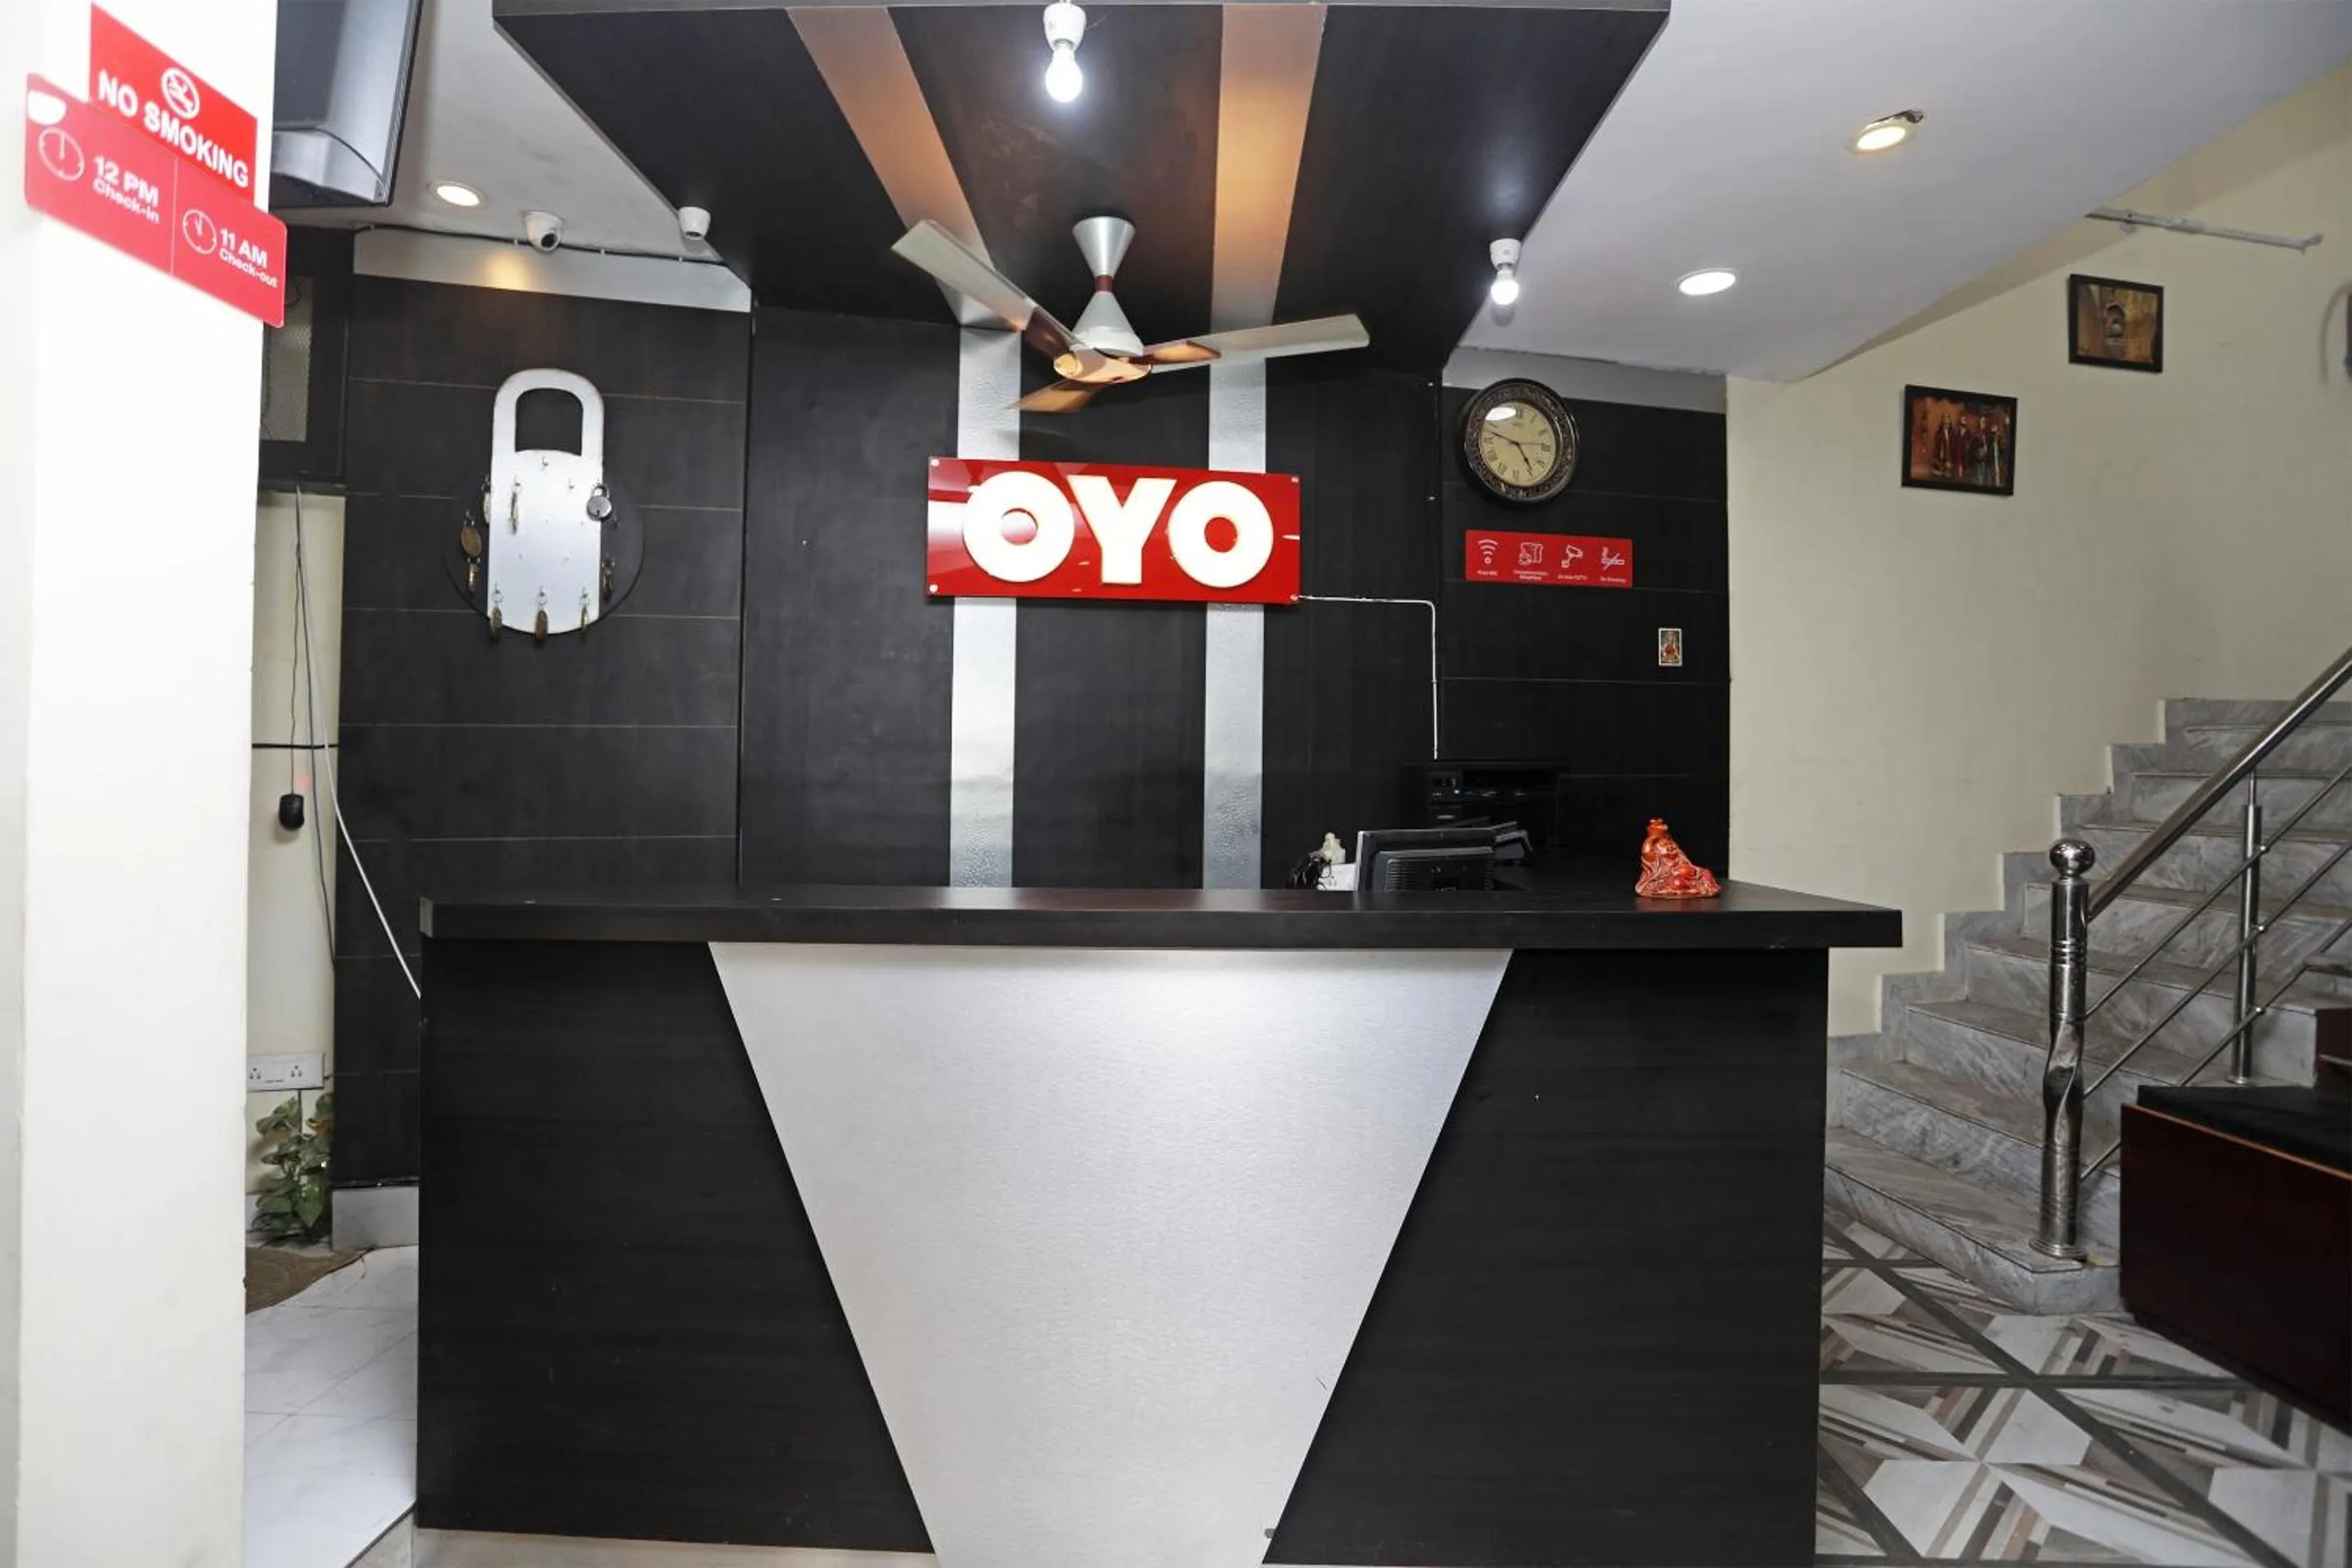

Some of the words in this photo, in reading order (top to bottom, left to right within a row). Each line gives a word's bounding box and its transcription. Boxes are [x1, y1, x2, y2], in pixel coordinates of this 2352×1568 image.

[99, 69, 138, 117] NO
[144, 100, 248, 188] SMOKING
[93, 155, 119, 185] 12
[124, 170, 159, 208] PM
[219, 247, 278, 288] Check-out
[220, 228, 235, 250] 11
[238, 238, 268, 269] AM
[962, 471, 1274, 588] OYO
